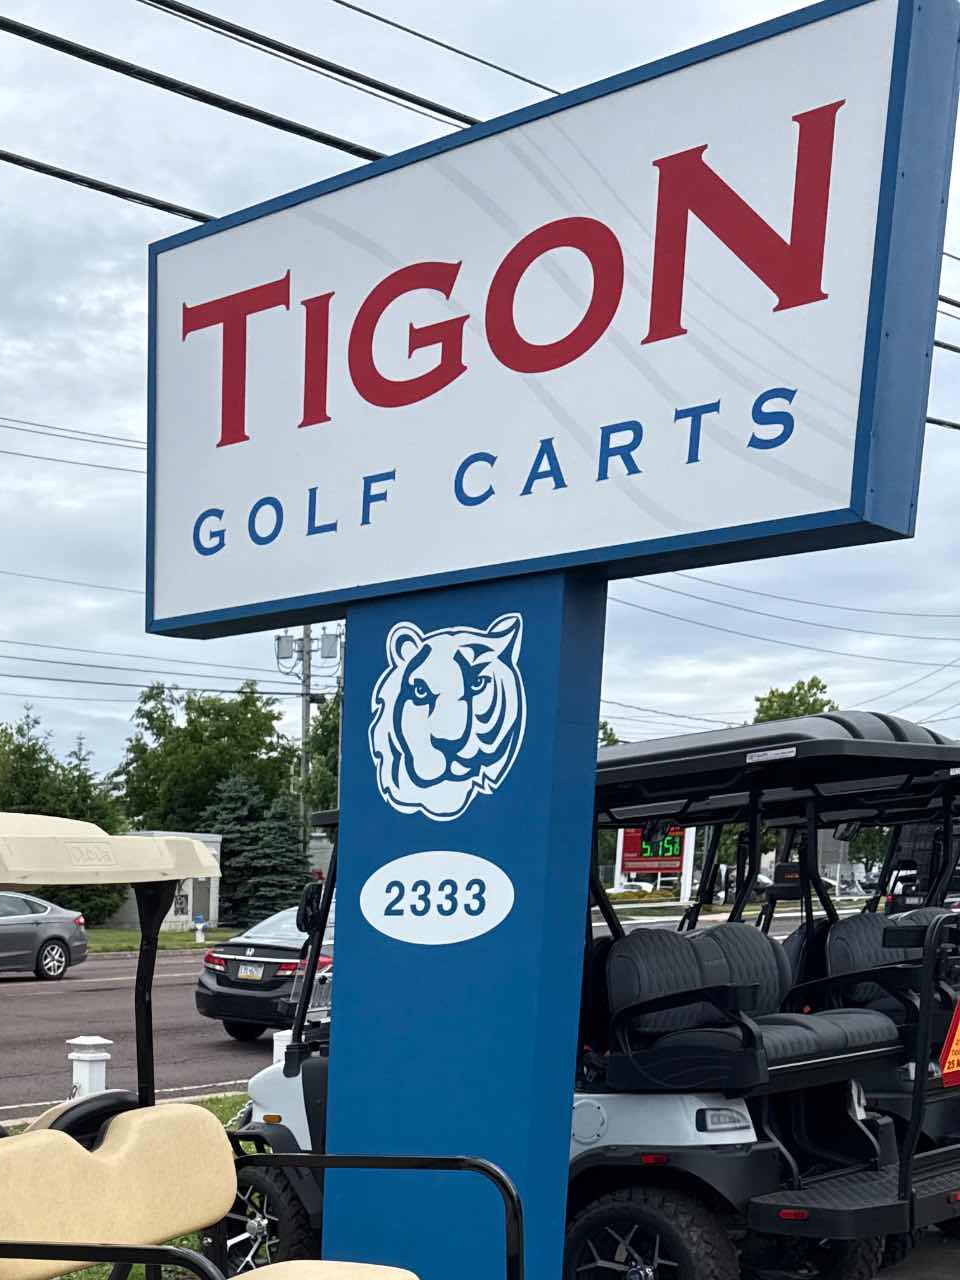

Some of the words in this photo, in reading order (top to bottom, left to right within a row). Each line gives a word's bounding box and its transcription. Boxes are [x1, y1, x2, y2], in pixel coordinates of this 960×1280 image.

[182, 100, 845, 448] TIGON
[192, 470, 396, 557] GOLF
[454, 387, 798, 507] CARTS
[383, 878, 486, 917] 2333
